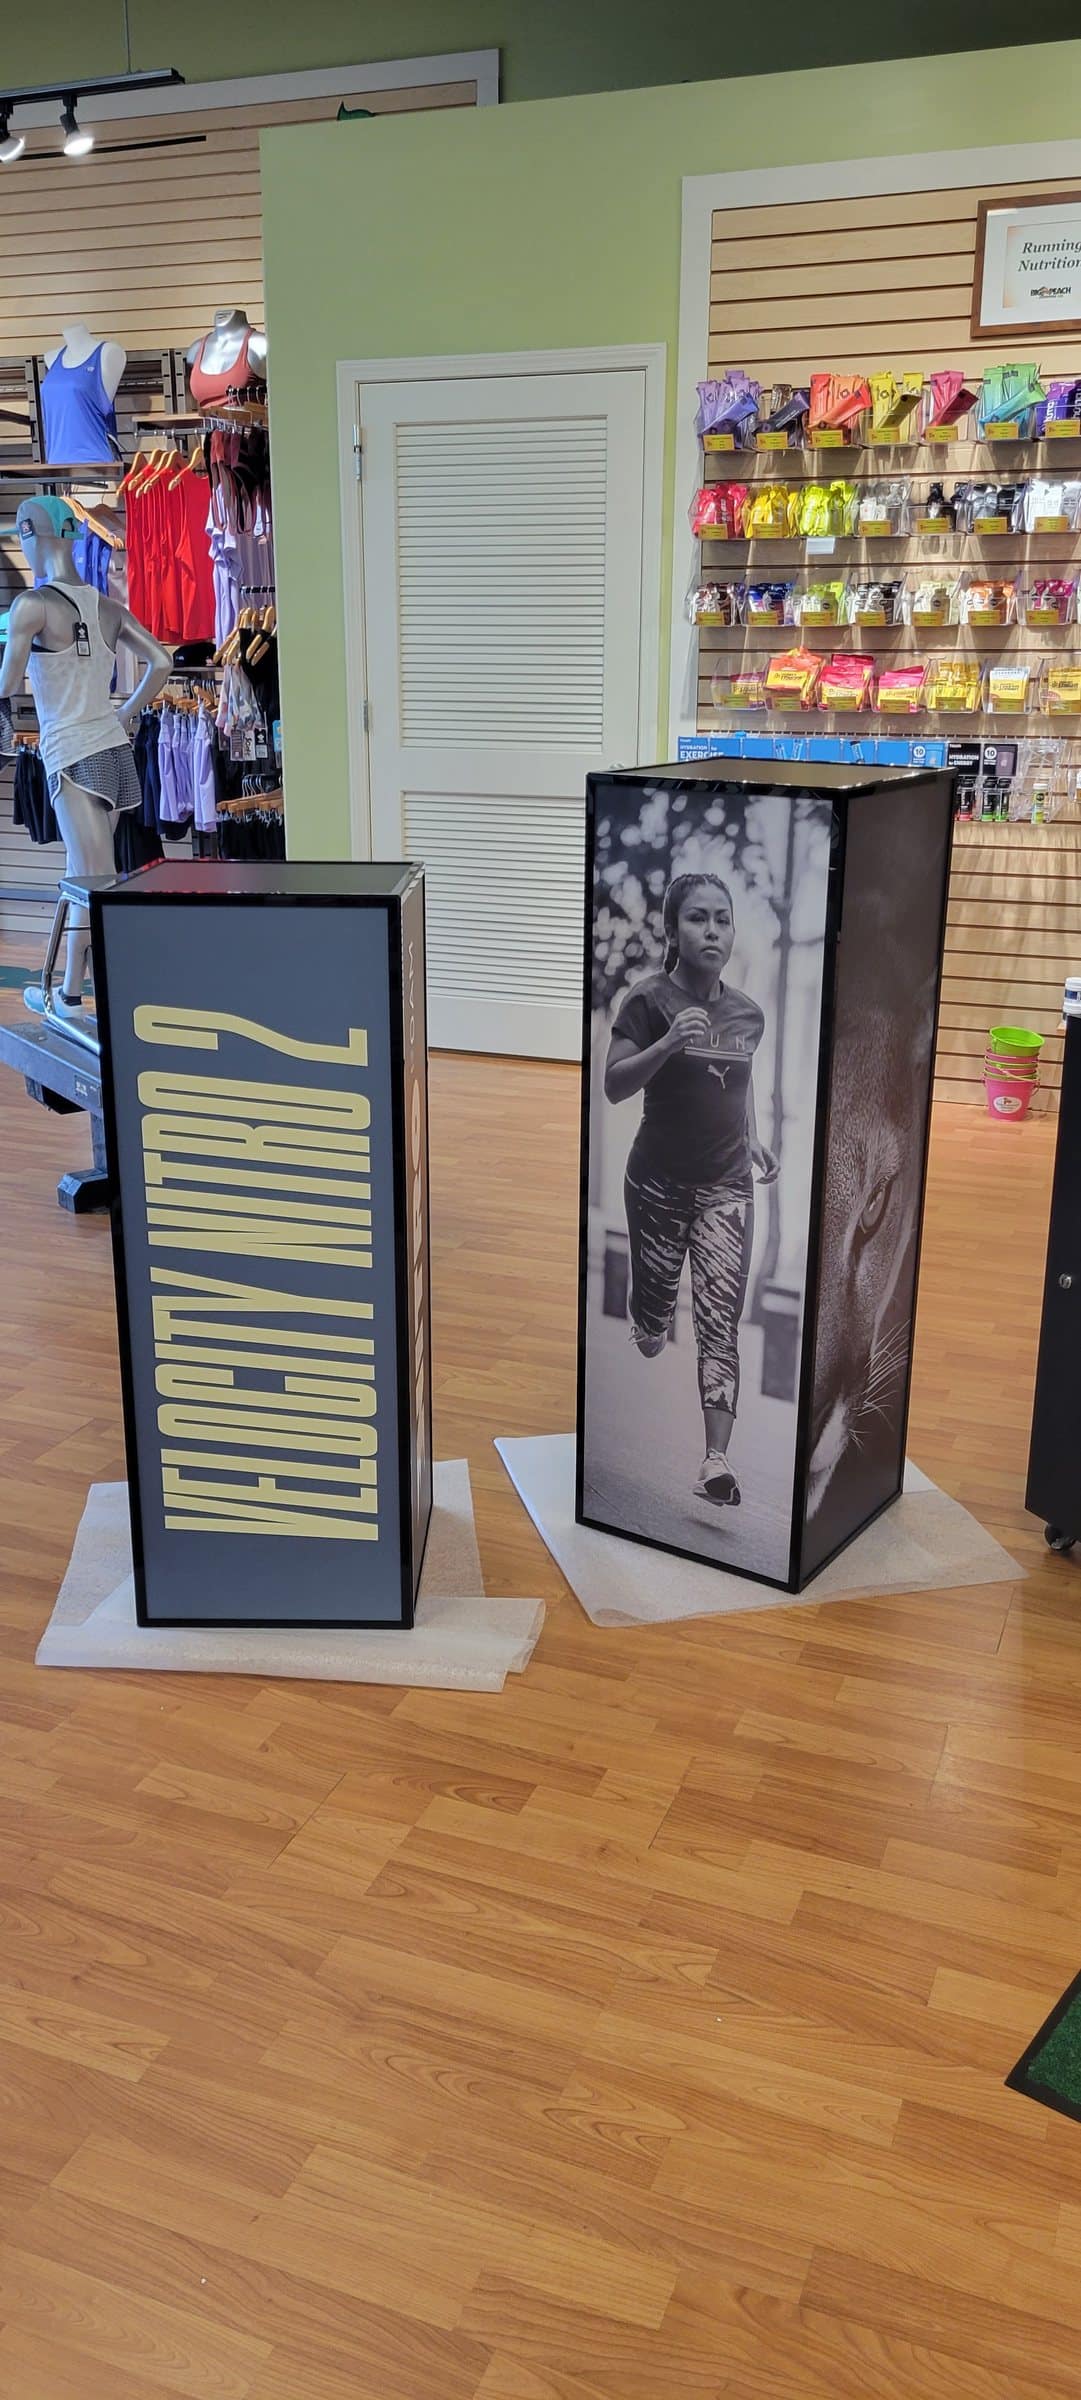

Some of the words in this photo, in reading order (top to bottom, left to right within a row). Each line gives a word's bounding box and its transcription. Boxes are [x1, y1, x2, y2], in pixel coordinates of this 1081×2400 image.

[1022, 239, 1081, 257] Running
[1049, 286, 1072, 296] PEACH
[133, 1004, 368, 1067] 2
[688, 1031, 746, 1052] UN
[137, 1070, 372, 1268] NITRO
[411, 1080, 426, 1516] NITRO
[151, 1267, 378, 1541] VELOCITY
